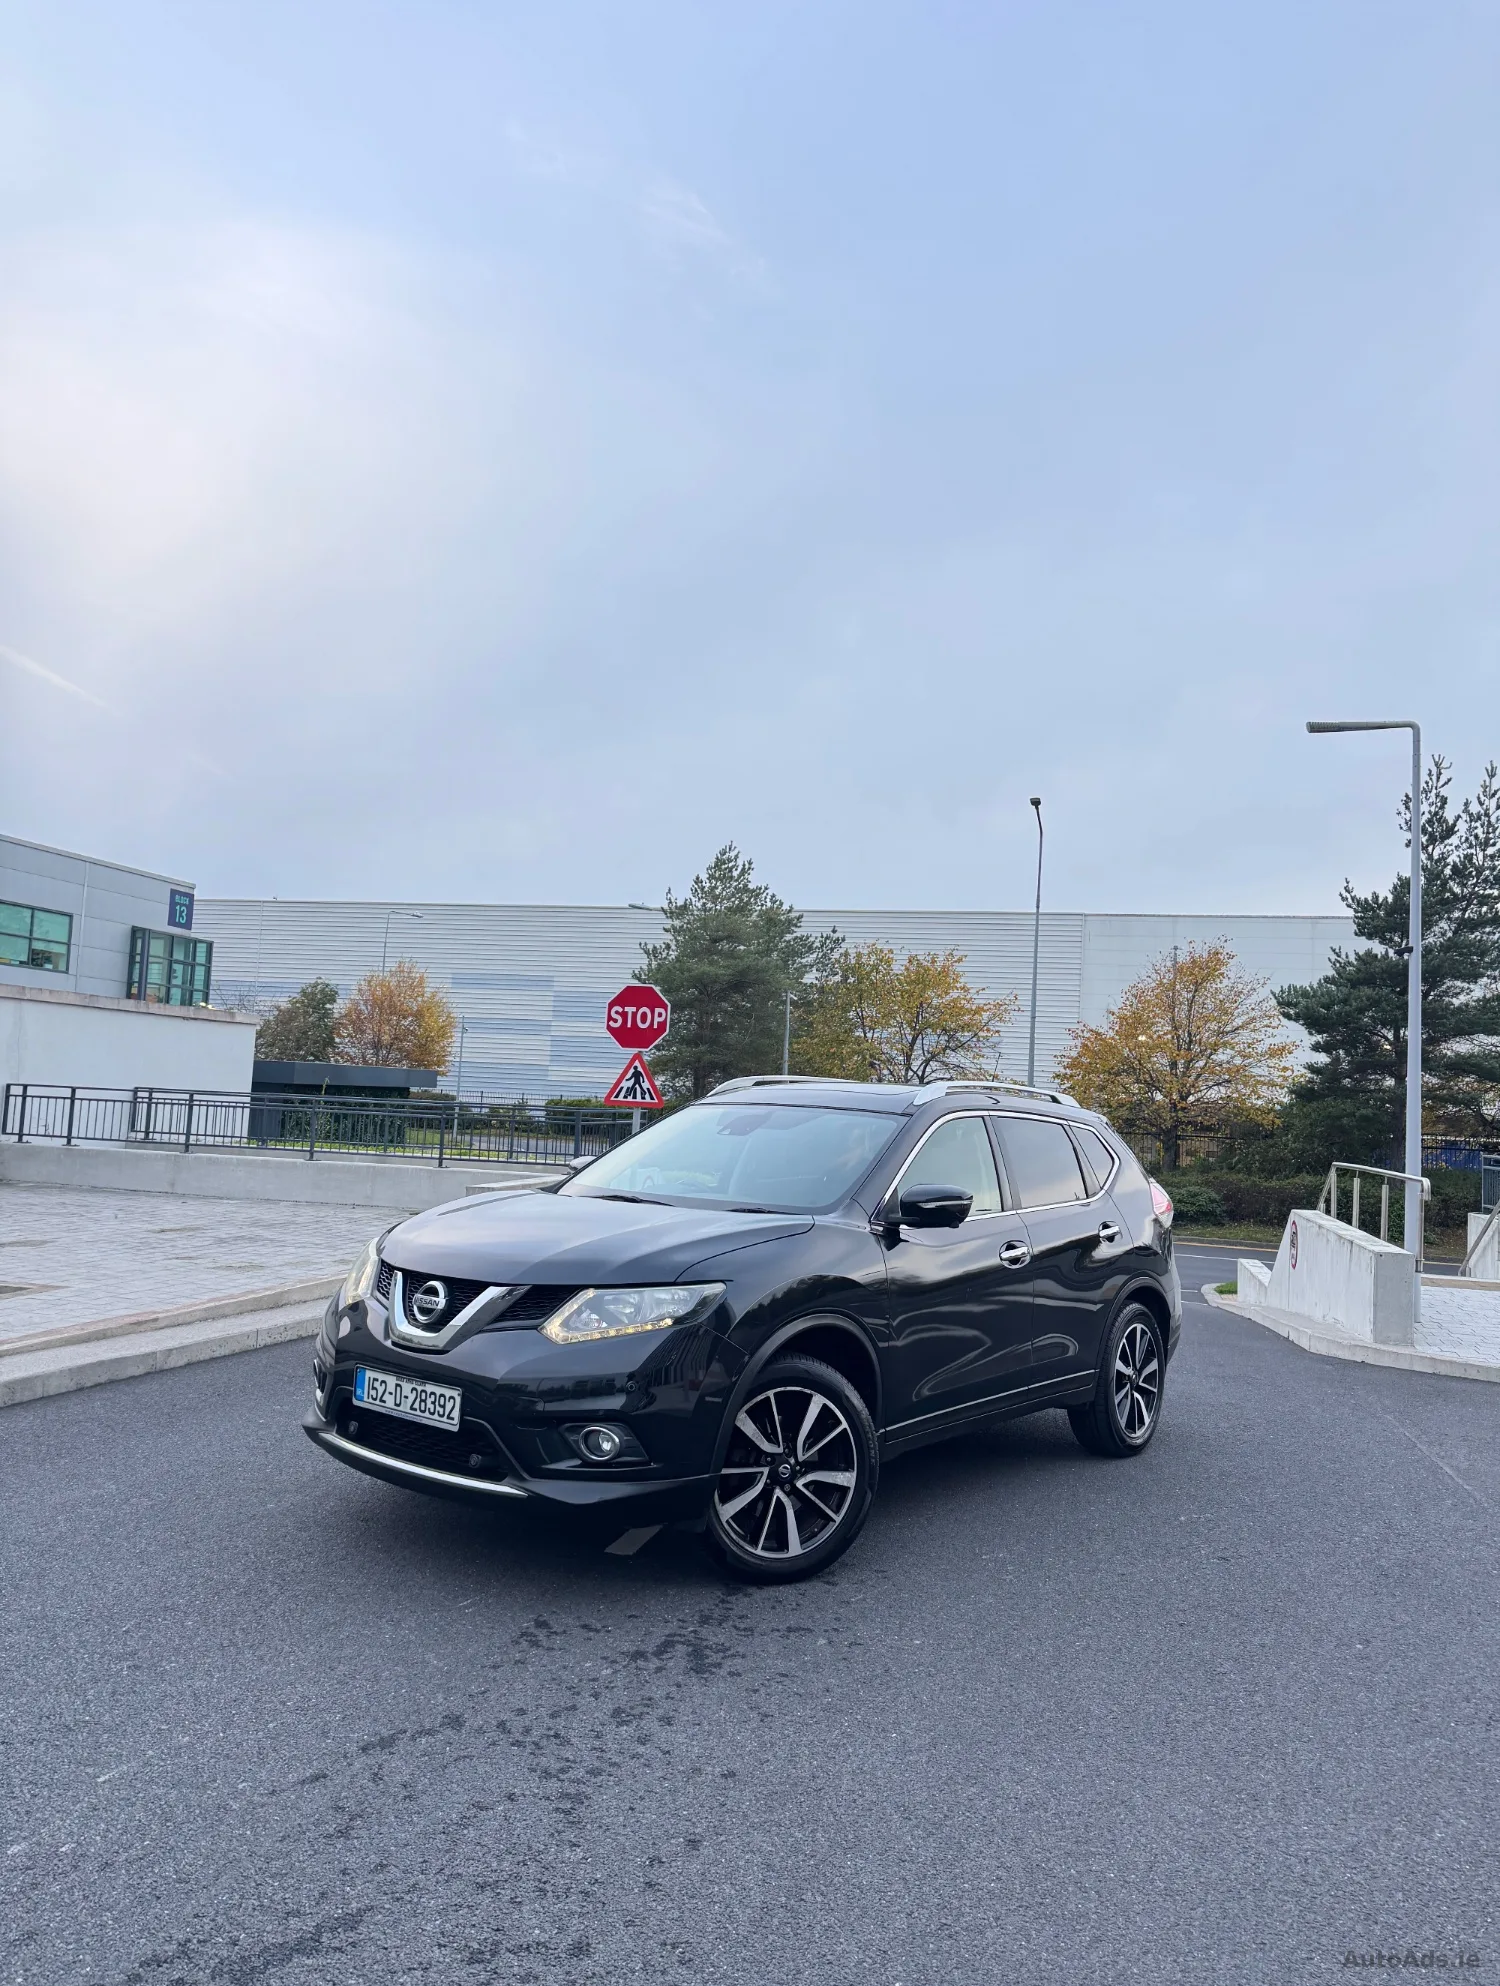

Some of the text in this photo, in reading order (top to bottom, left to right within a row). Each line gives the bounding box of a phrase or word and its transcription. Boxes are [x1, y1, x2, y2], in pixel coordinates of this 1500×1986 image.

[175, 895, 189, 905] BLOCK
[175, 905, 187, 924] 13
[608, 1005, 666, 1029] STOP
[367, 1376, 456, 1421] 152-D-28392
